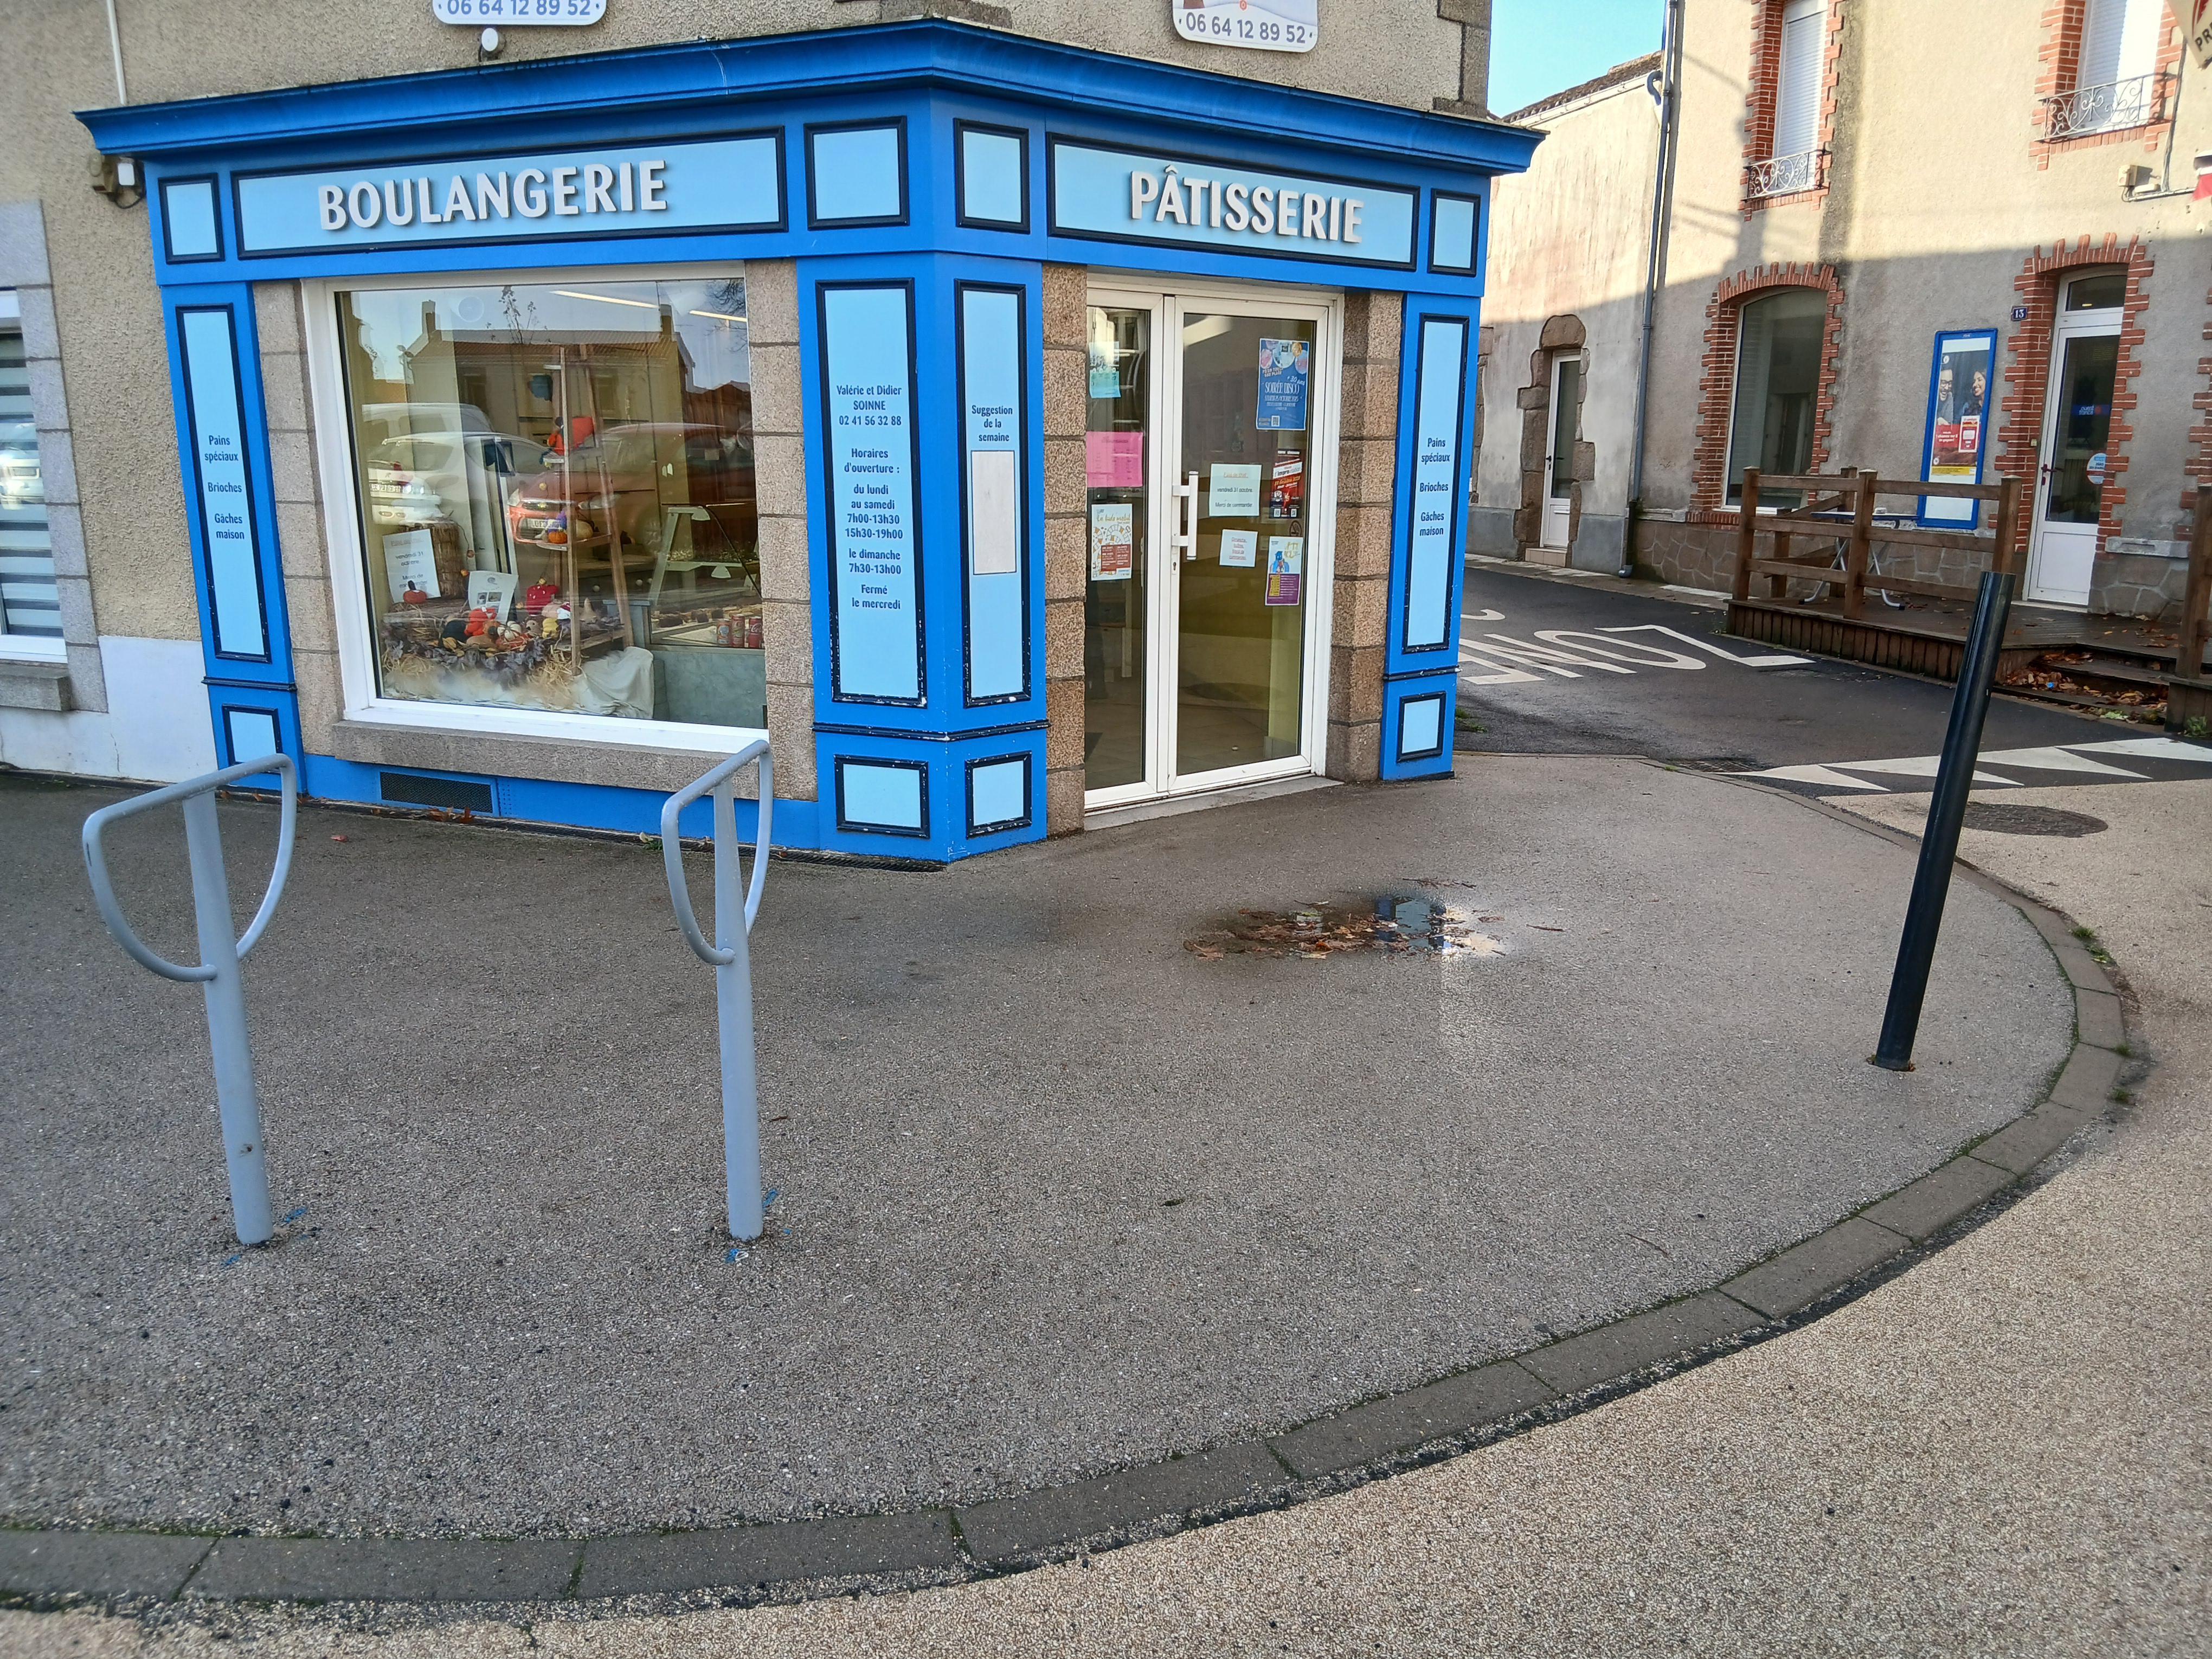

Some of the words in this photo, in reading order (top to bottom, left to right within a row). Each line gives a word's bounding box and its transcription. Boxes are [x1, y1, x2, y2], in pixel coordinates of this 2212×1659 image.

[447, 0, 472, 15] 06
[479, 0, 503, 15] 64
[511, 0, 529, 15] 12
[536, 0, 560, 15] 89
[568, 0, 590, 15] 52
[1186, 12, 1206, 33] 06
[1212, 16, 1232, 36] 64
[1237, 20, 1253, 38] 12
[1259, 22, 1280, 41] 89
[1286, 25, 1306, 43] 52
[318, 160, 667, 230] BOULANGERIE
[1130, 164, 1365, 243] PÂTISSERIE
[2015, 309, 2024, 318] 13
[837, 384, 864, 395] Valérie
[866, 386, 874, 395] et
[877, 384, 902, 395] Didier
[1265, 380, 1283, 394] SOIRÉE
[1284, 382, 1300, 395] DISCO
[853, 400, 886, 410] SOINNE
[972, 404, 1013, 417] Suggestion
[839, 415, 849, 425] 02
[852, 415, 861, 426] 41
[865, 416, 875, 426] 56
[878, 416, 888, 426] 32
[891, 416, 902, 426] 88
[984, 418, 993, 428] de
[995, 418, 1001, 428] la
[209, 435, 230, 446] Pains
[979, 432, 1009, 441] semaine
[1427, 437, 1446, 448] Pains
[204, 451, 239, 464] spéciaux
[851, 448, 889, 458] Horaires
[1421, 453, 1450, 465] spéciaux
[844, 462, 893, 473] d'ouverture
[208, 482, 242, 492] Brioches
[853, 484, 864, 494] du
[867, 484, 889, 494] lundi
[1419, 481, 1449, 492] Brioches
[864, 499, 895, 509] samedi
[214, 513, 243, 524] Gâches
[847, 513, 900, 524] 7h00-13h30
[1420, 511, 1444, 522] Gâches
[216, 529, 245, 539] maison
[845, 528, 903, 539] 15h30-19h00
[1419, 526, 1444, 536] maison
[849, 548, 857, 558] le
[859, 549, 901, 560] dimanche
[849, 563, 901, 574] 7h30-13h00
[861, 584, 888, 594] Fermé
[852, 597, 859, 607] le
[862, 599, 901, 609] mercredi
